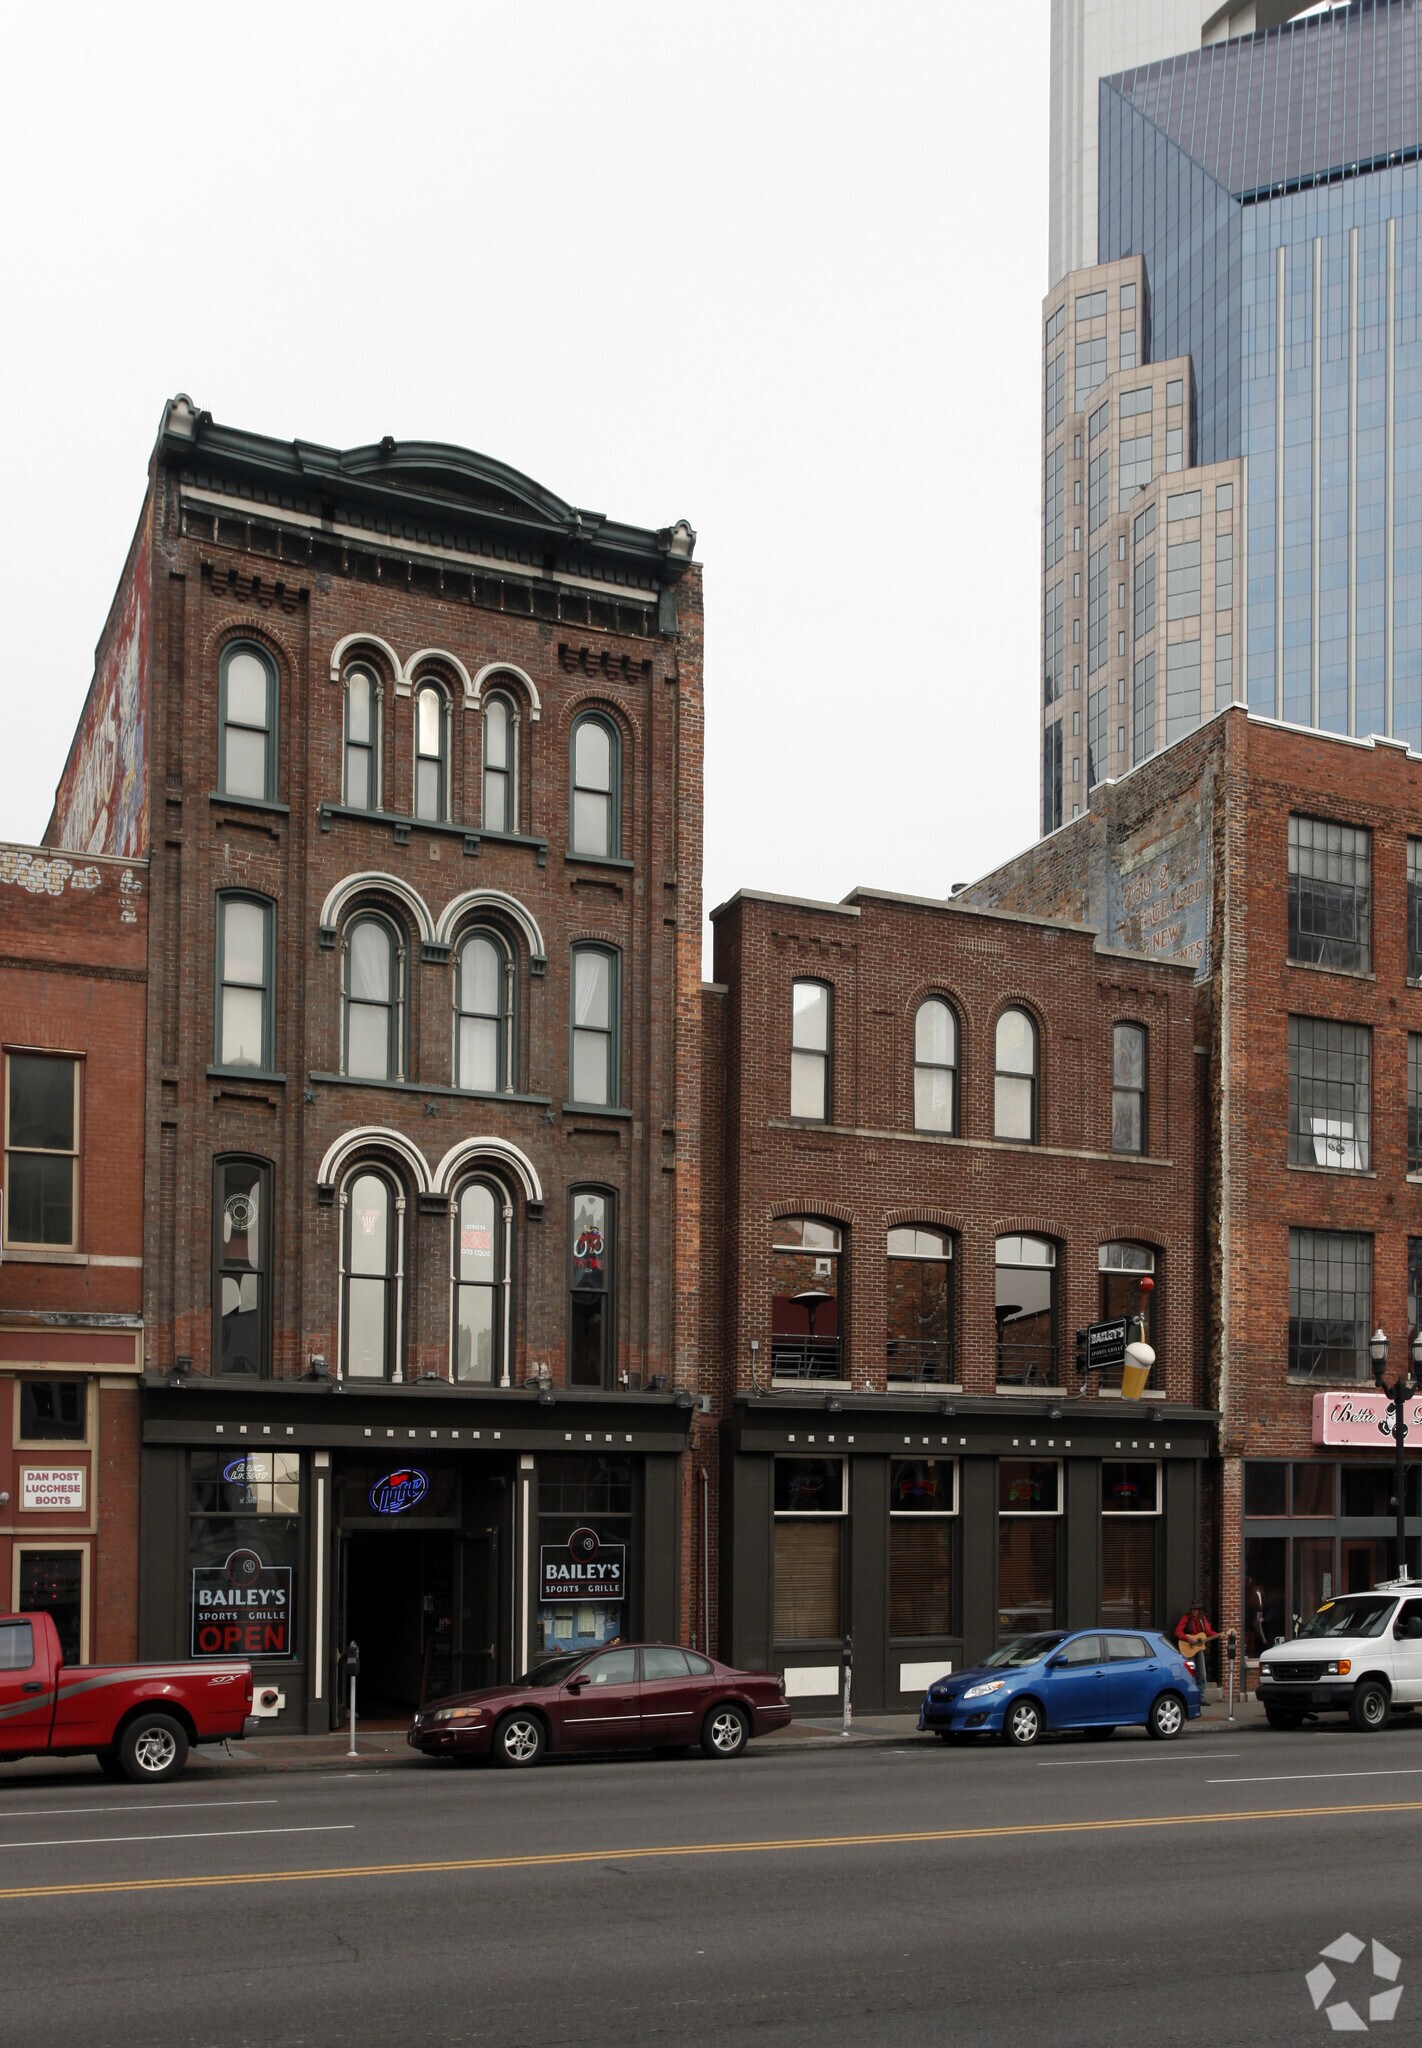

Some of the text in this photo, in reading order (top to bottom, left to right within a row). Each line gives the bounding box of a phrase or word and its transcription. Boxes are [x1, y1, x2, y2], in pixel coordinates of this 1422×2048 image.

[1171, 880, 1204, 912] USED
[1151, 922, 1179, 953] NEW
[1091, 1345, 1123, 1357] SPORTS GRILLE
[1330, 1402, 1377, 1425] Bettie
[27, 1473, 79, 1481] DAN POST
[25, 1484, 81, 1493] LUCCHESE
[35, 1496, 71, 1505] BOOTS
[546, 1564, 620, 1579] BAILEY'S
[588, 1584, 620, 1592] GRILLE
[199, 1589, 286, 1606] BAILEY'S
[198, 1611, 285, 1620] SPORTS GRILLE
[199, 1625, 284, 1652] OPEN
